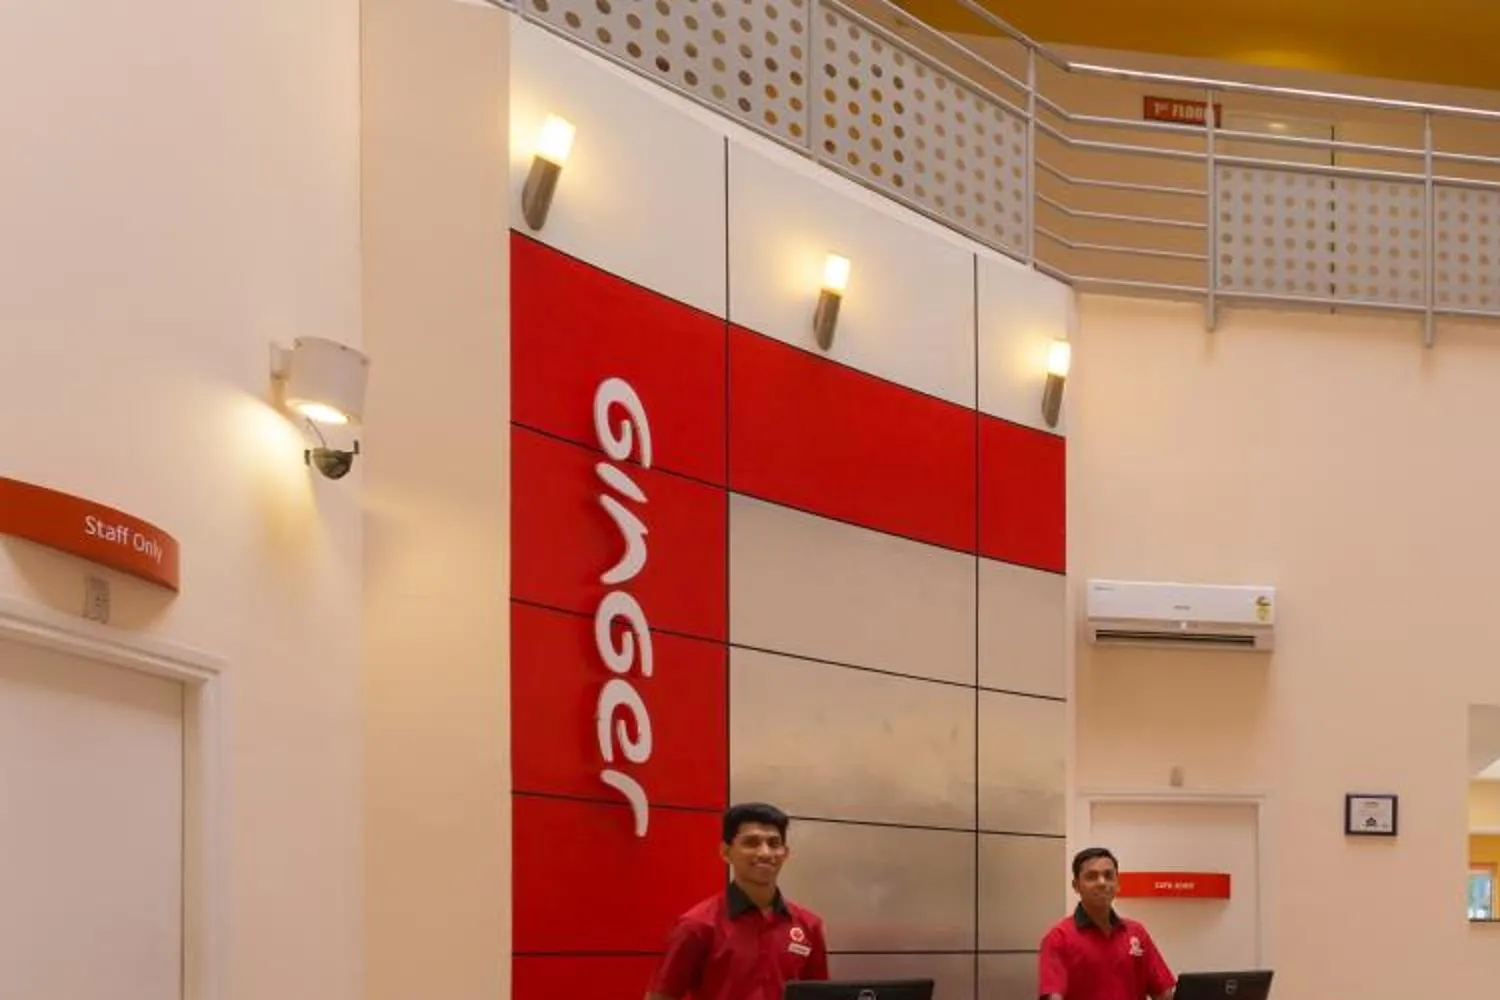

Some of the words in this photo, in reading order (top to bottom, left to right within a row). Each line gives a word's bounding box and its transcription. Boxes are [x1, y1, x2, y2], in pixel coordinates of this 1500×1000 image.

[1171, 103, 1210, 120] FLOO
[84, 515, 129, 545] Staff
[133, 533, 163, 565] Only
